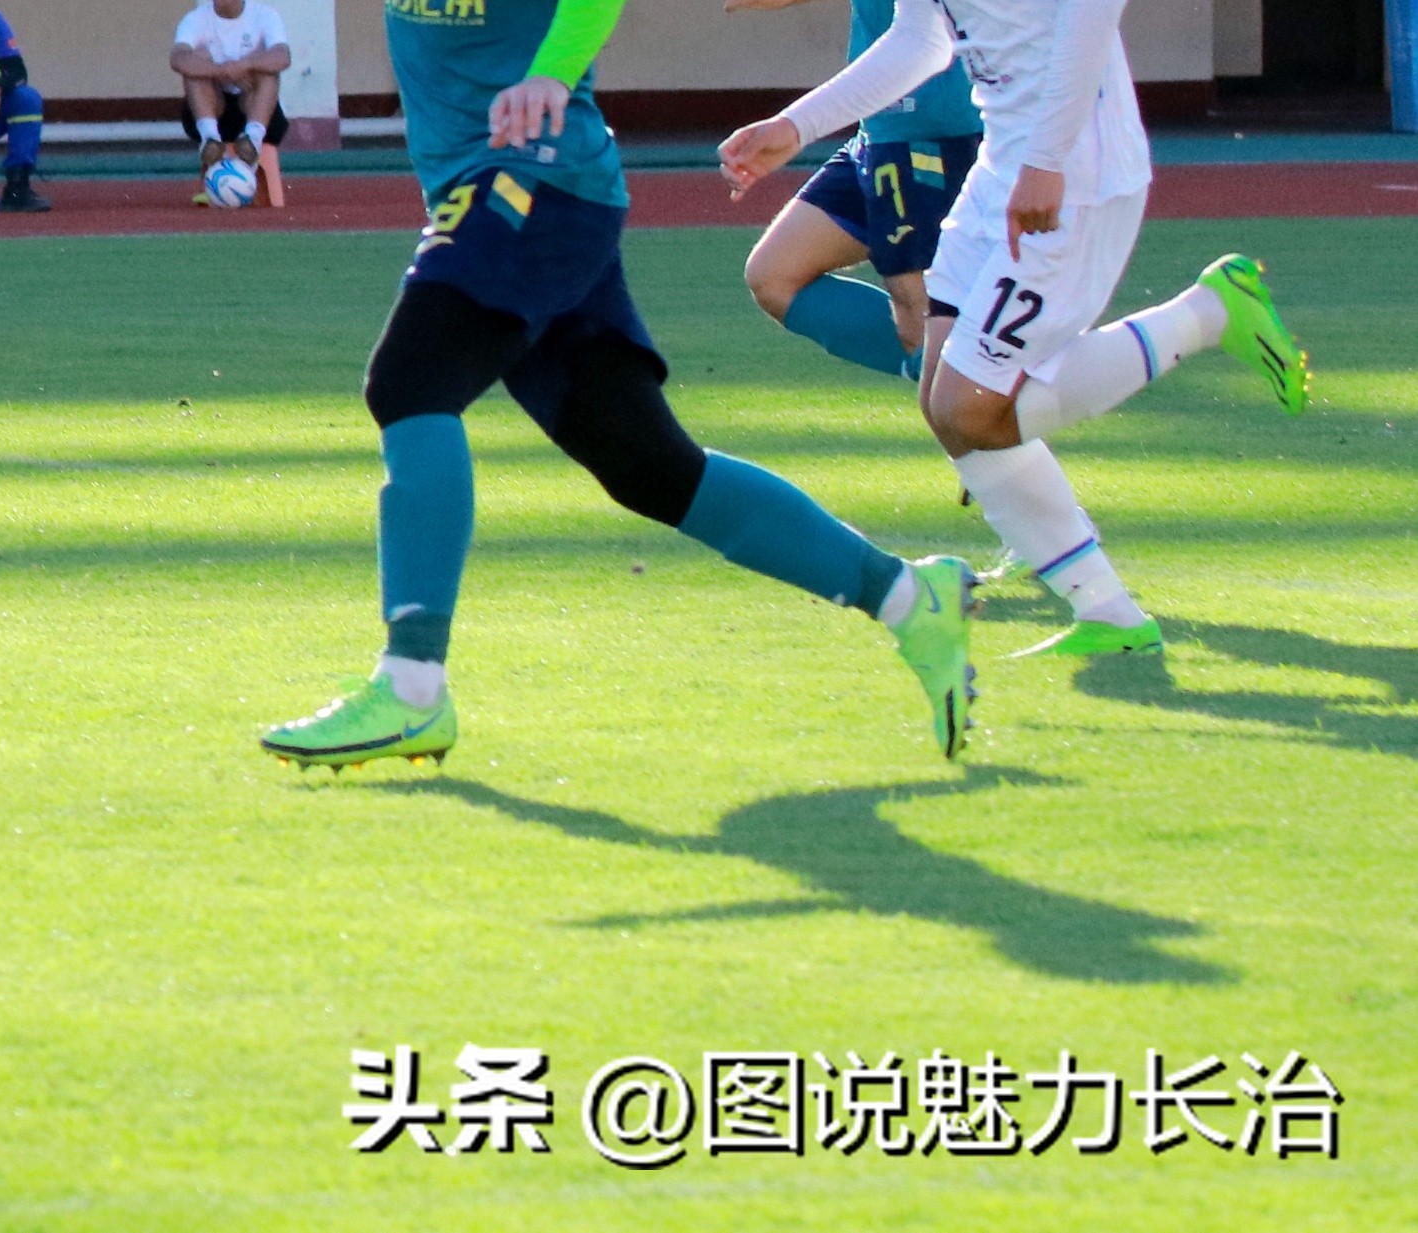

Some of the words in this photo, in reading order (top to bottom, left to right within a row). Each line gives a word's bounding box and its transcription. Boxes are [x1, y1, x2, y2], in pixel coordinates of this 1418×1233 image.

[431, 183, 477, 233] 8
[874, 163, 905, 219] 7
[981, 276, 1044, 350] 12
